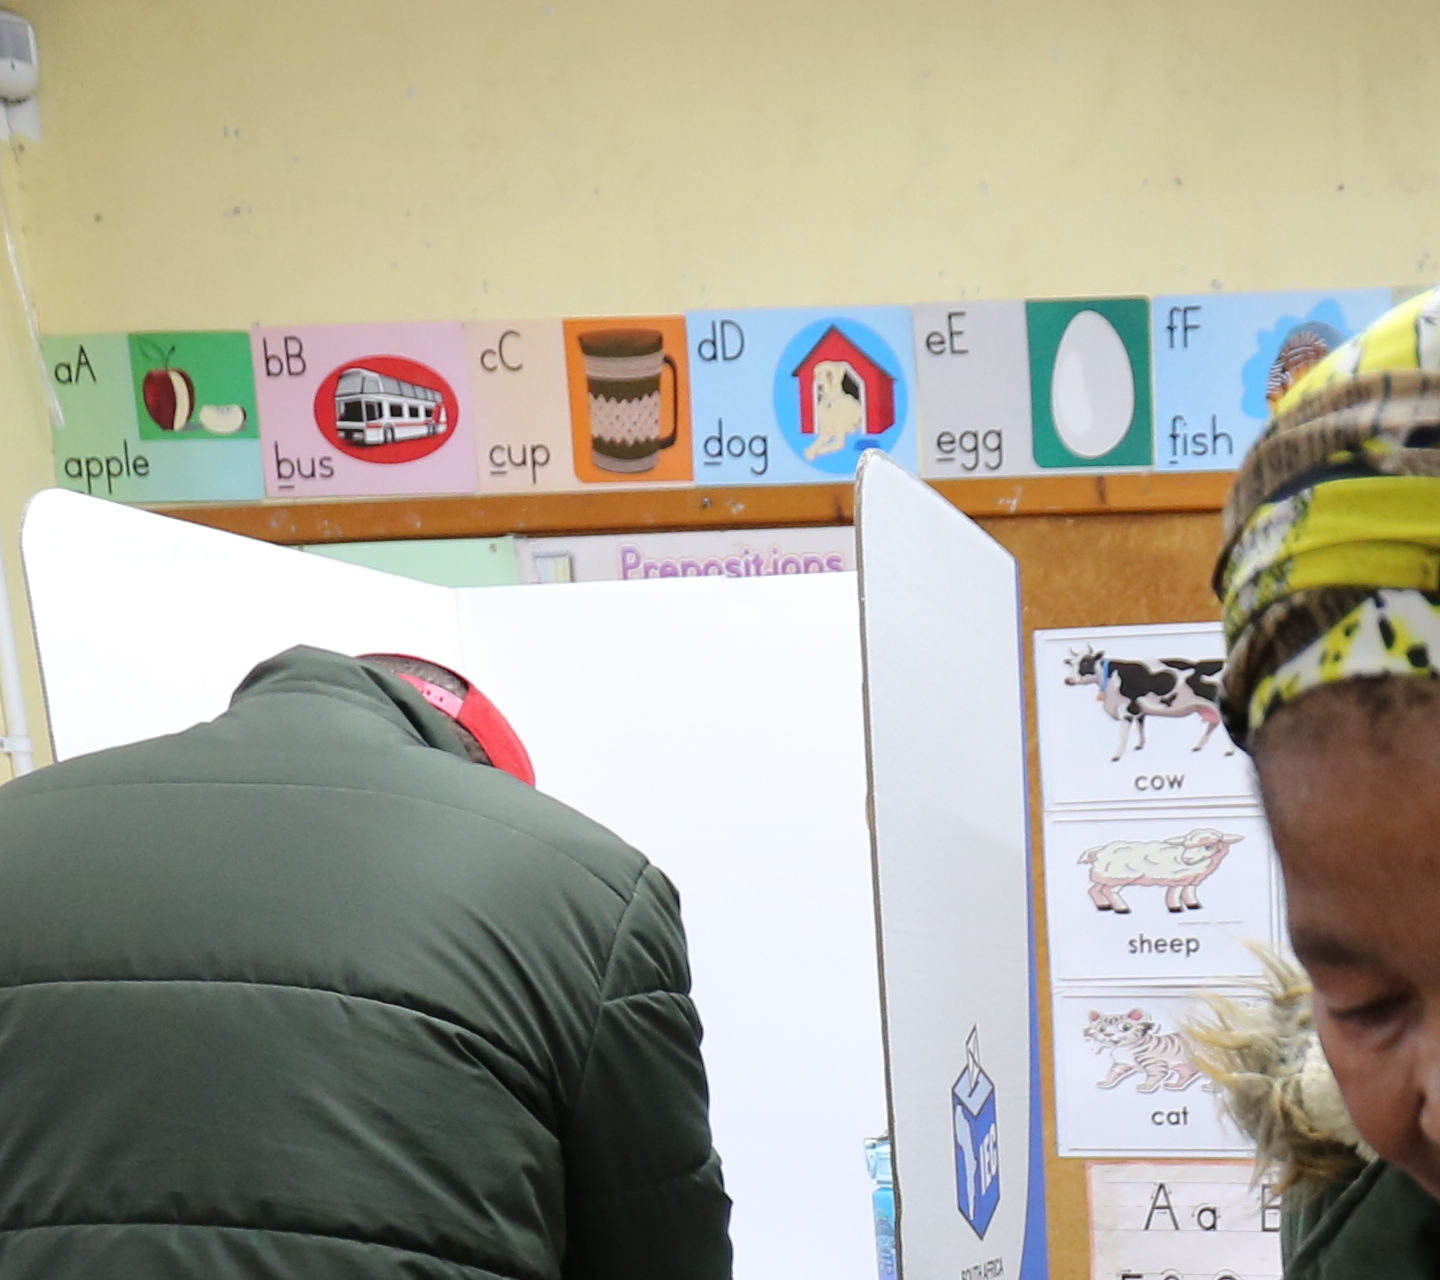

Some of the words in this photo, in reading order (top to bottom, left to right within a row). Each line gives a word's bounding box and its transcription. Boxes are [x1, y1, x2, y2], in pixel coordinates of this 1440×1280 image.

[697, 320, 745, 363] dD
[925, 312, 969, 355] eE
[1166, 306, 1201, 350] fF
[53, 344, 97, 387] aA
[263, 336, 306, 378] bB
[480, 331, 523, 372] cC
[489, 440, 550, 471] cup
[702, 423, 769, 475] dog
[936, 426, 1004, 471] egg
[1169, 414, 1234, 458] fish
[63, 439, 150, 494] apple
[275, 444, 335, 483] bus
[1134, 772, 1186, 792] cow
[1127, 932, 1201, 957] sheep
[1151, 1106, 1189, 1127] cat
[979, 1122, 998, 1196] IEC
